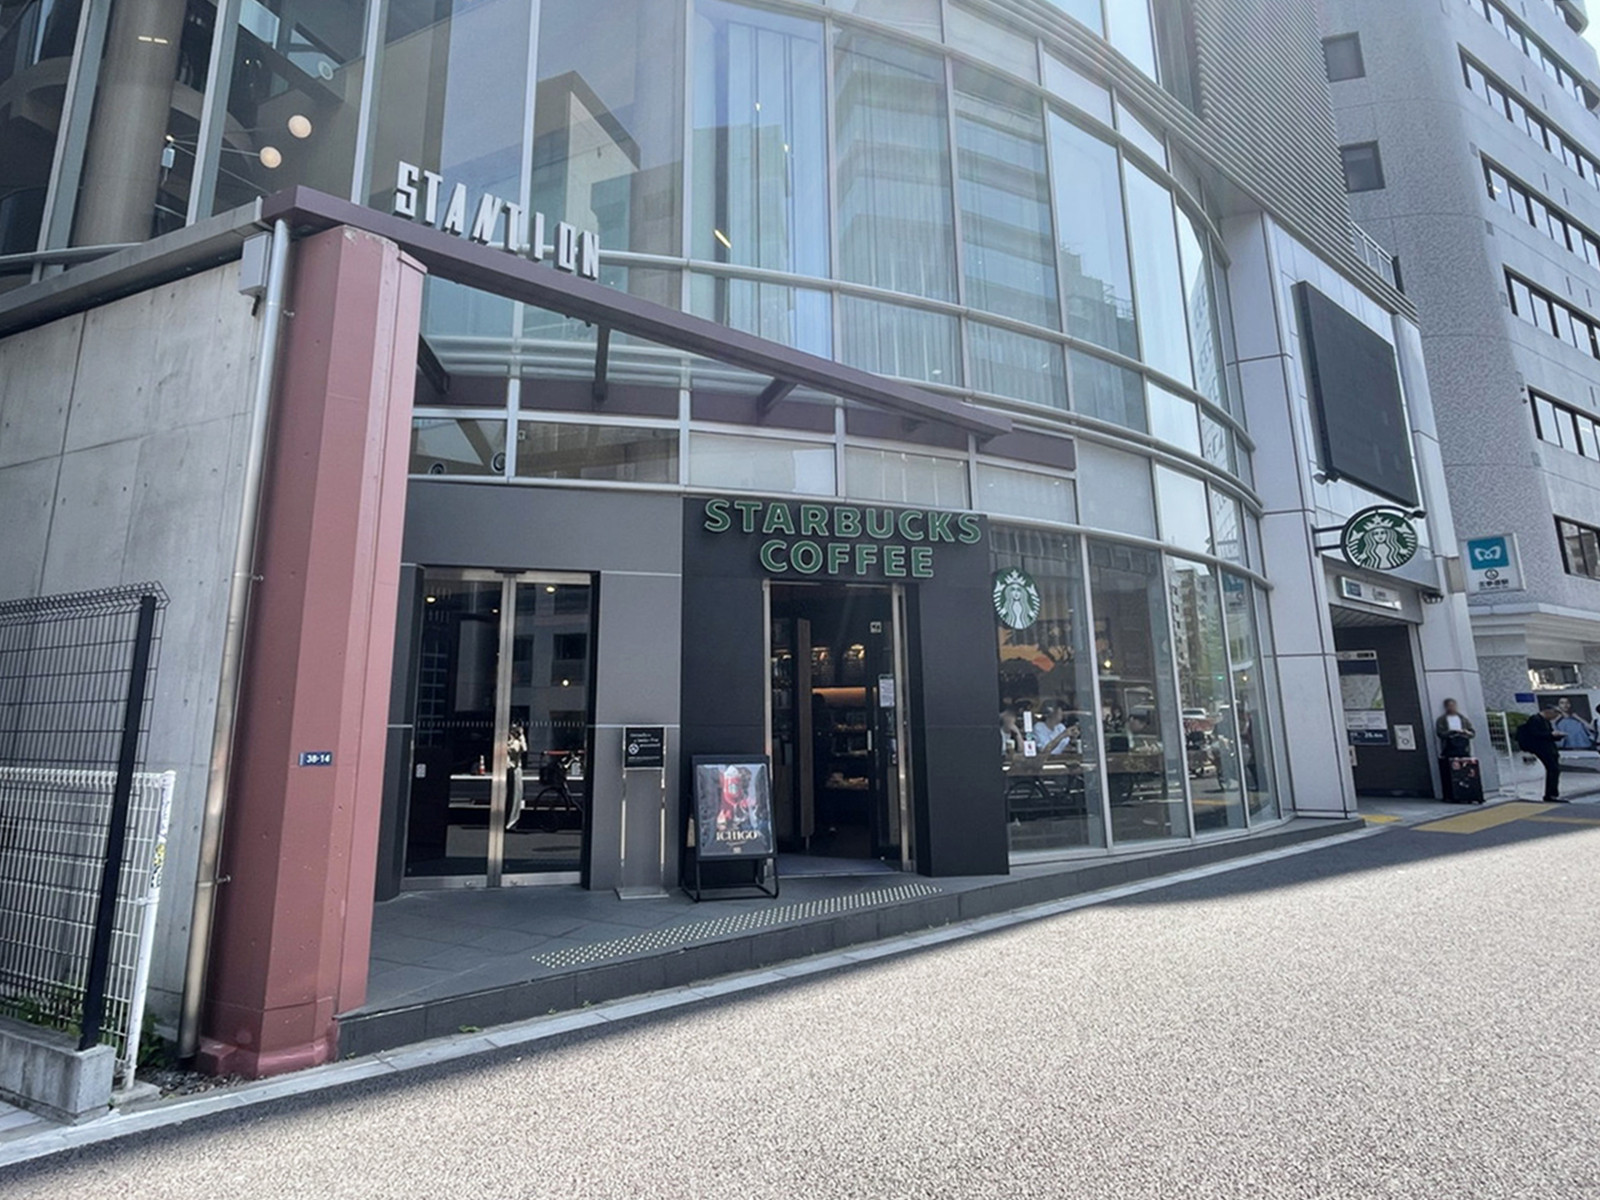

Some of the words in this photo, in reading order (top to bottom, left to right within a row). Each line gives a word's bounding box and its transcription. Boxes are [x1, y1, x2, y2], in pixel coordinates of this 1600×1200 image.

[393, 161, 600, 281] STANTION
[704, 499, 982, 544] STARBUCKS
[760, 539, 934, 578] COFFEE
